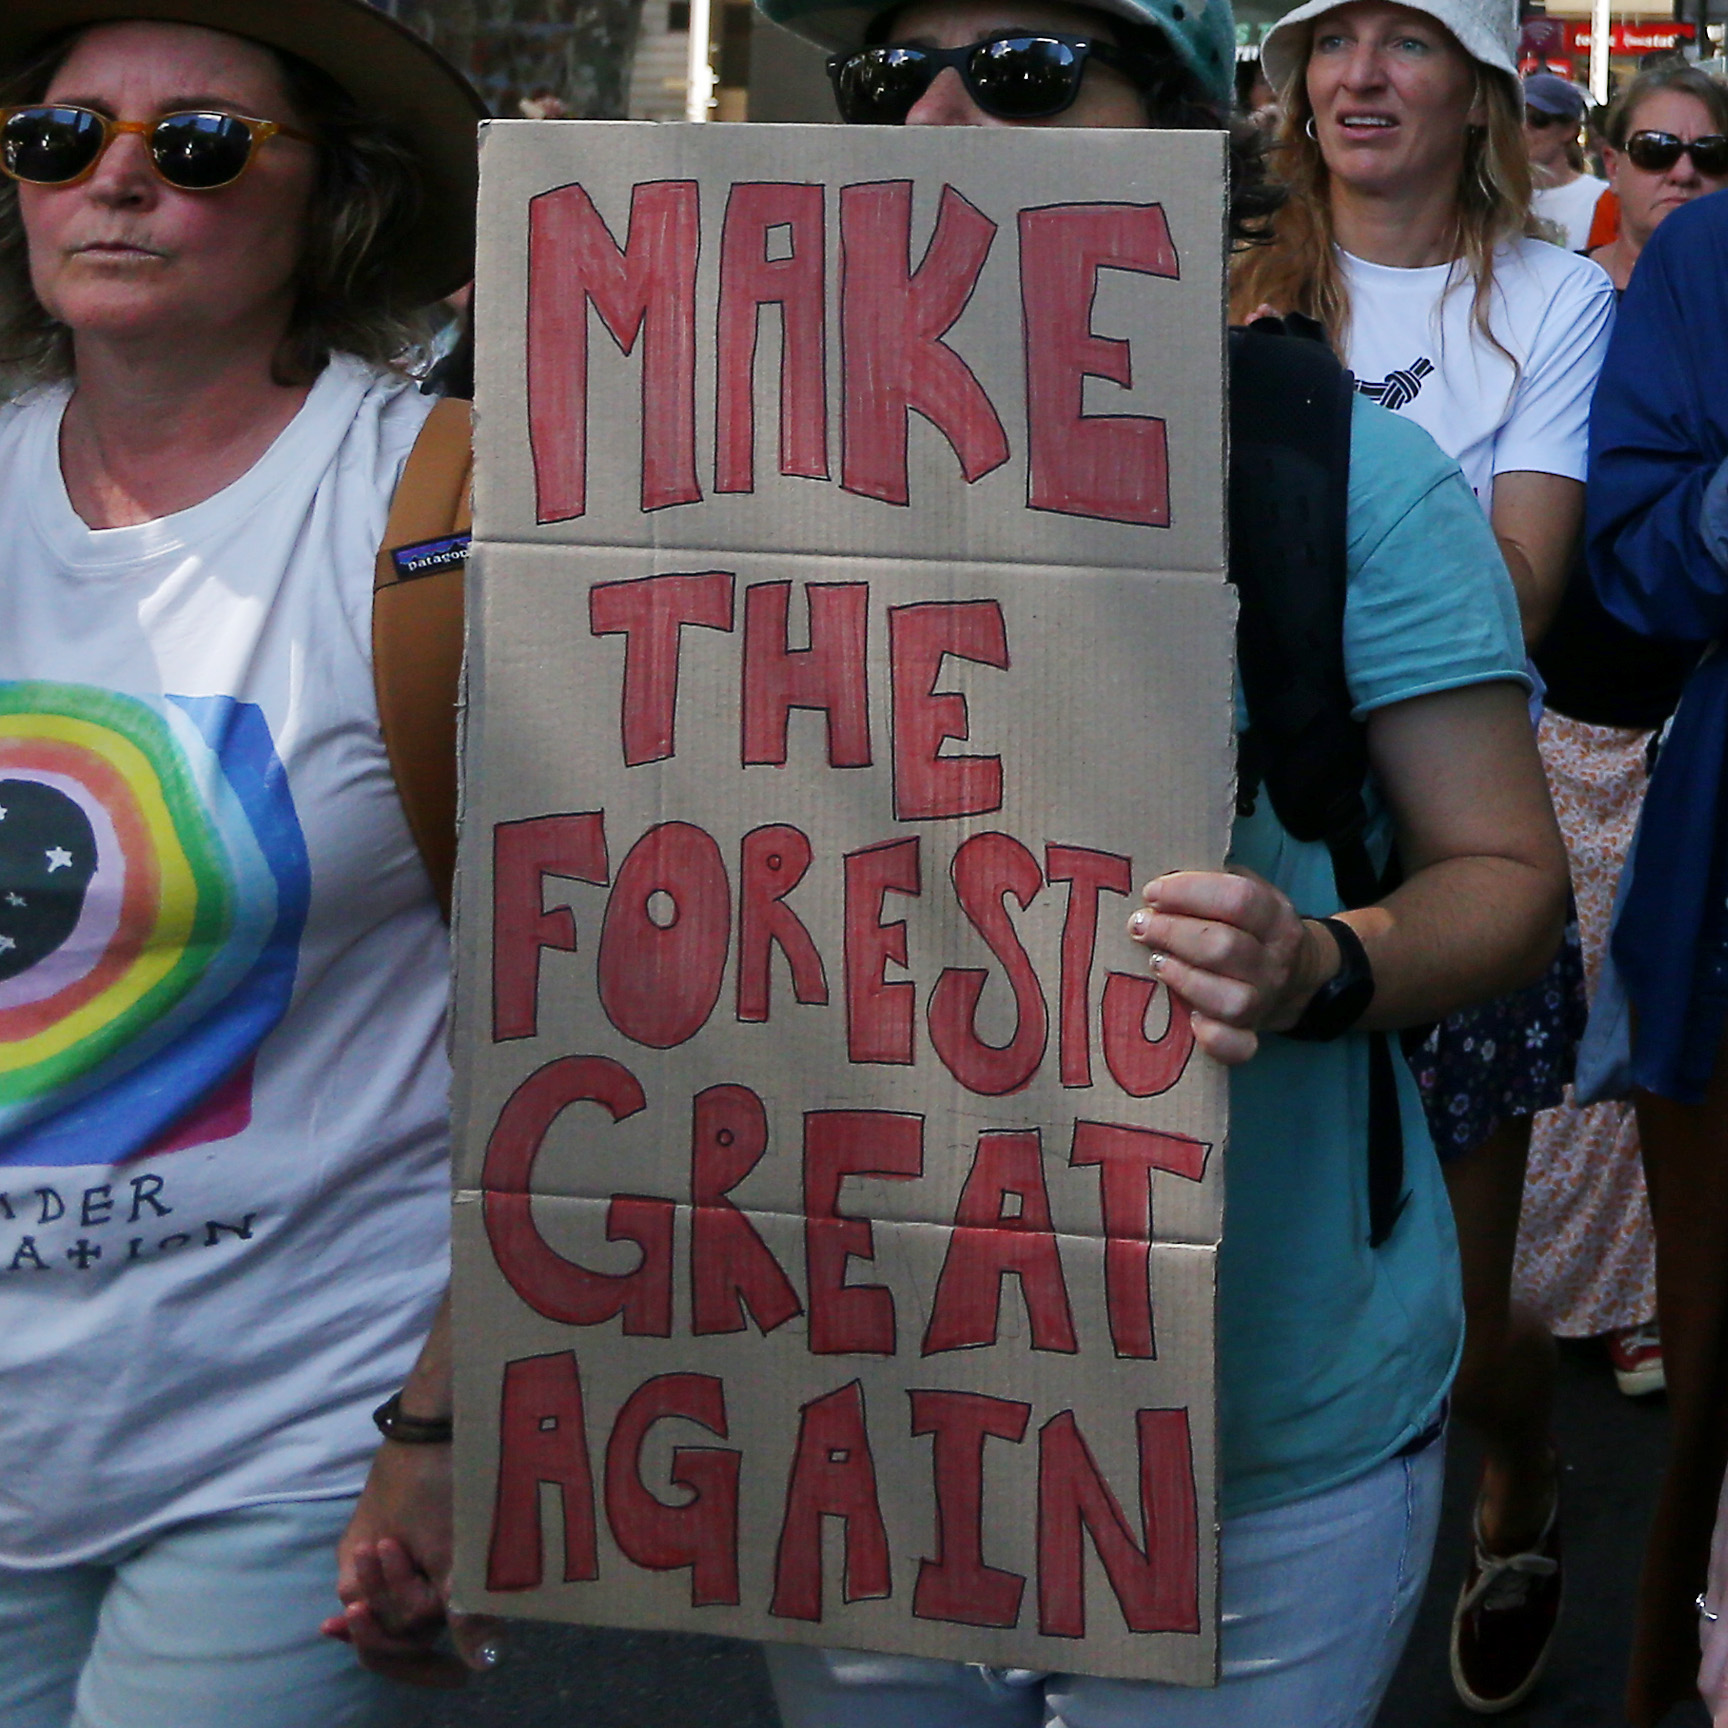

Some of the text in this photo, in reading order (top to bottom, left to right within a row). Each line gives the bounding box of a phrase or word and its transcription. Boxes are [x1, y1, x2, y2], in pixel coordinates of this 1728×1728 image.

[528, 179, 1179, 528] MAKE
[407, 549, 472, 572] patagon
[590, 572, 1010, 821] THE
[481, 1054, 1214, 1361] GREAT
[485, 1350, 1202, 1639] AGAIN
